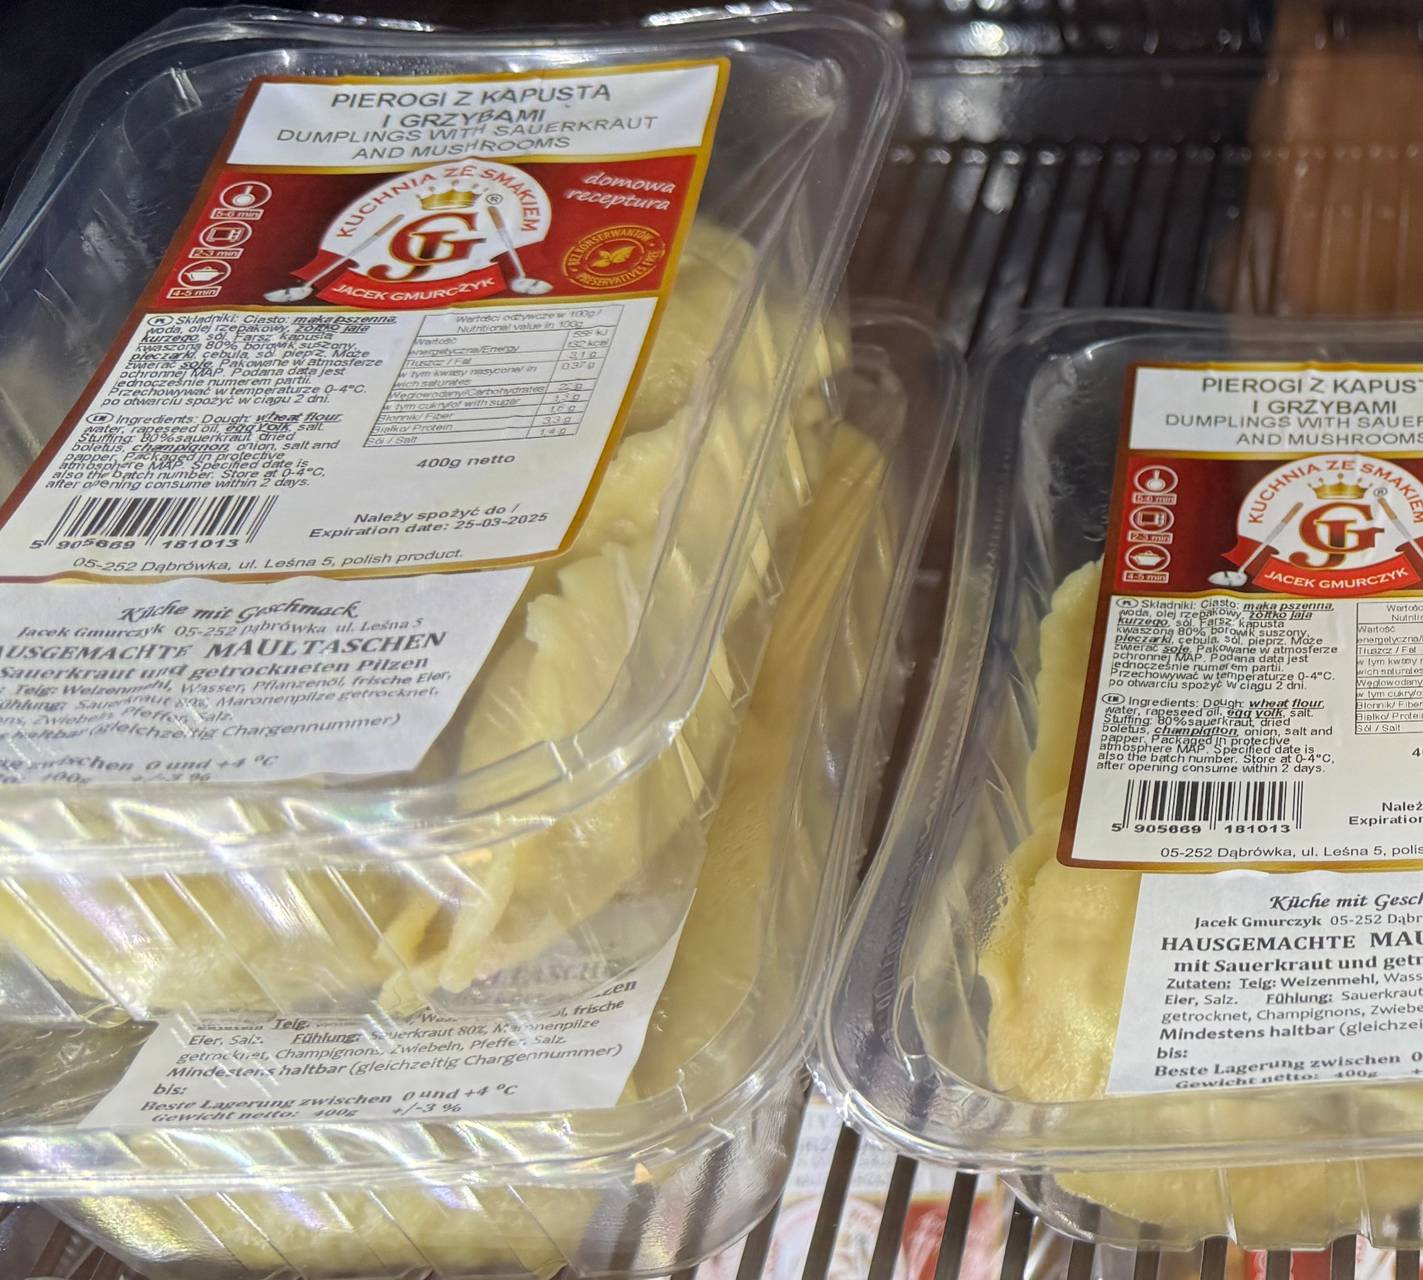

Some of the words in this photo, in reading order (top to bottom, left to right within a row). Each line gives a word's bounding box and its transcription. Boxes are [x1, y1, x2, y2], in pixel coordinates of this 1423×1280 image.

[331, 88, 446, 108] PIEROGI
[455, 90, 474, 106] Z
[383, 112, 390, 127] I
[399, 107, 546, 128] GRZYBAMI
[277, 126, 421, 143] DUMPLINGS
[430, 125, 488, 142] WITH
[496, 116, 658, 137] SAUERKRAUT
[353, 146, 403, 159] AND
[411, 136, 570, 158] MUSHROOMS
[583, 172, 675, 194] domowa
[337, 173, 435, 238] KUCHNIA
[444, 165, 474, 178] ZE
[481, 167, 539, 231] SMAKIEM
[563, 188, 669, 211] receptura
[331, 280, 385, 300] JACEK
[390, 276, 496, 301] GMURCZYK
[1202, 378, 1302, 394] PIEROGI
[1310, 378, 1324, 393] Z
[1253, 401, 1258, 414] I
[1269, 400, 1396, 415] GRZYBAMI
[1166, 414, 1291, 429] DUMPLINGS
[1297, 416, 1350, 429] WITH
[1236, 433, 1282, 446] AND
[417, 456, 461, 469] 400g
[468, 455, 515, 466] netto
[1247, 462, 1320, 525] KUCHNIA
[1328, 460, 1355, 471] ZE
[354, 510, 413, 526] Należy
[418, 506, 479, 524] spożyć
[485, 504, 505, 516] do
[309, 523, 400, 541] Expiration
[403, 521, 449, 534] date:
[454, 511, 549, 531] 25-03-2025
[73, 556, 137, 571] 05-252
[140, 556, 229, 575] Dąbrówka,
[239, 556, 258, 570] ul.
[264, 553, 316, 569] Leśna
[320, 555, 336, 569] 5,
[342, 551, 392, 568] polish
[397, 548, 462, 564] product.
[1265, 570, 1314, 587] JACEK
[1320, 567, 1409, 589] GMURCZYK
[1142, 600, 1196, 610] Składniki:
[1201, 599, 1238, 609] Ciasto:
[205, 631, 448, 659] MAULTASCHEN
[192, 658, 355, 680] getrockneten
[356, 656, 428, 672] Pilzen
[1129, 698, 1199, 708] Ingredients:
[1203, 699, 1243, 709] Dough:
[1098, 753, 1123, 762] also
[1128, 753, 1147, 762] the
[1151, 753, 1185, 763] batch
[1190, 754, 1238, 764] number.
[1243, 754, 1276, 764] Store
[1280, 754, 1291, 764] at
[1097, 761, 1123, 770] after
[1128, 762, 1178, 774] opening
[1182, 764, 1237, 773] consume
[1242, 763, 1277, 773] within
[1282, 764, 1288, 773] 2
[1293, 763, 1326, 775] days.
[1112, 823, 1122, 832] 5
[1134, 824, 1201, 833] 905669
[1224, 824, 1291, 833] 181013
[1161, 847, 1212, 859] 05-252
[1217, 845, 1296, 861] Dąbrówka,
[1301, 845, 1318, 857] ul.
[1324, 844, 1369, 857] Leśna
[1373, 845, 1387, 858] 5,
[1270, 893, 1330, 911] Küche
[1336, 894, 1367, 908] mit
[1195, 916, 1237, 930] Jacek
[1242, 916, 1321, 928] Gmurczyk
[1331, 913, 1382, 926] 05-252
[1162, 936, 1356, 951] HAUSGEMACHTE
[1174, 960, 1209, 972] mit
[1214, 958, 1333, 972] Sauerkraut
[1338, 956, 1377, 969] und
[1167, 978, 1231, 989] Zutaten:
[1240, 979, 1276, 991] Teig:
[1281, 974, 1379, 988] Weizenmehl,
[1165, 994, 1198, 1006] Eier,
[1204, 994, 1238, 1004] Salz.
[1266, 993, 1333, 1004] Fühlung:
[1162, 1010, 1251, 1024] getrocknet,
[1257, 1007, 1366, 1023] Champignons,
[1160, 1028, 1265, 1041] Mindestens
[1270, 1024, 1335, 1038] haltbar
[277, 1062, 347, 1076] haltbar
[349, 1054, 460, 1077] (gleichzeitig
[463, 1044, 625, 1068] Chargennummer)
[1157, 1047, 1188, 1059] bis:
